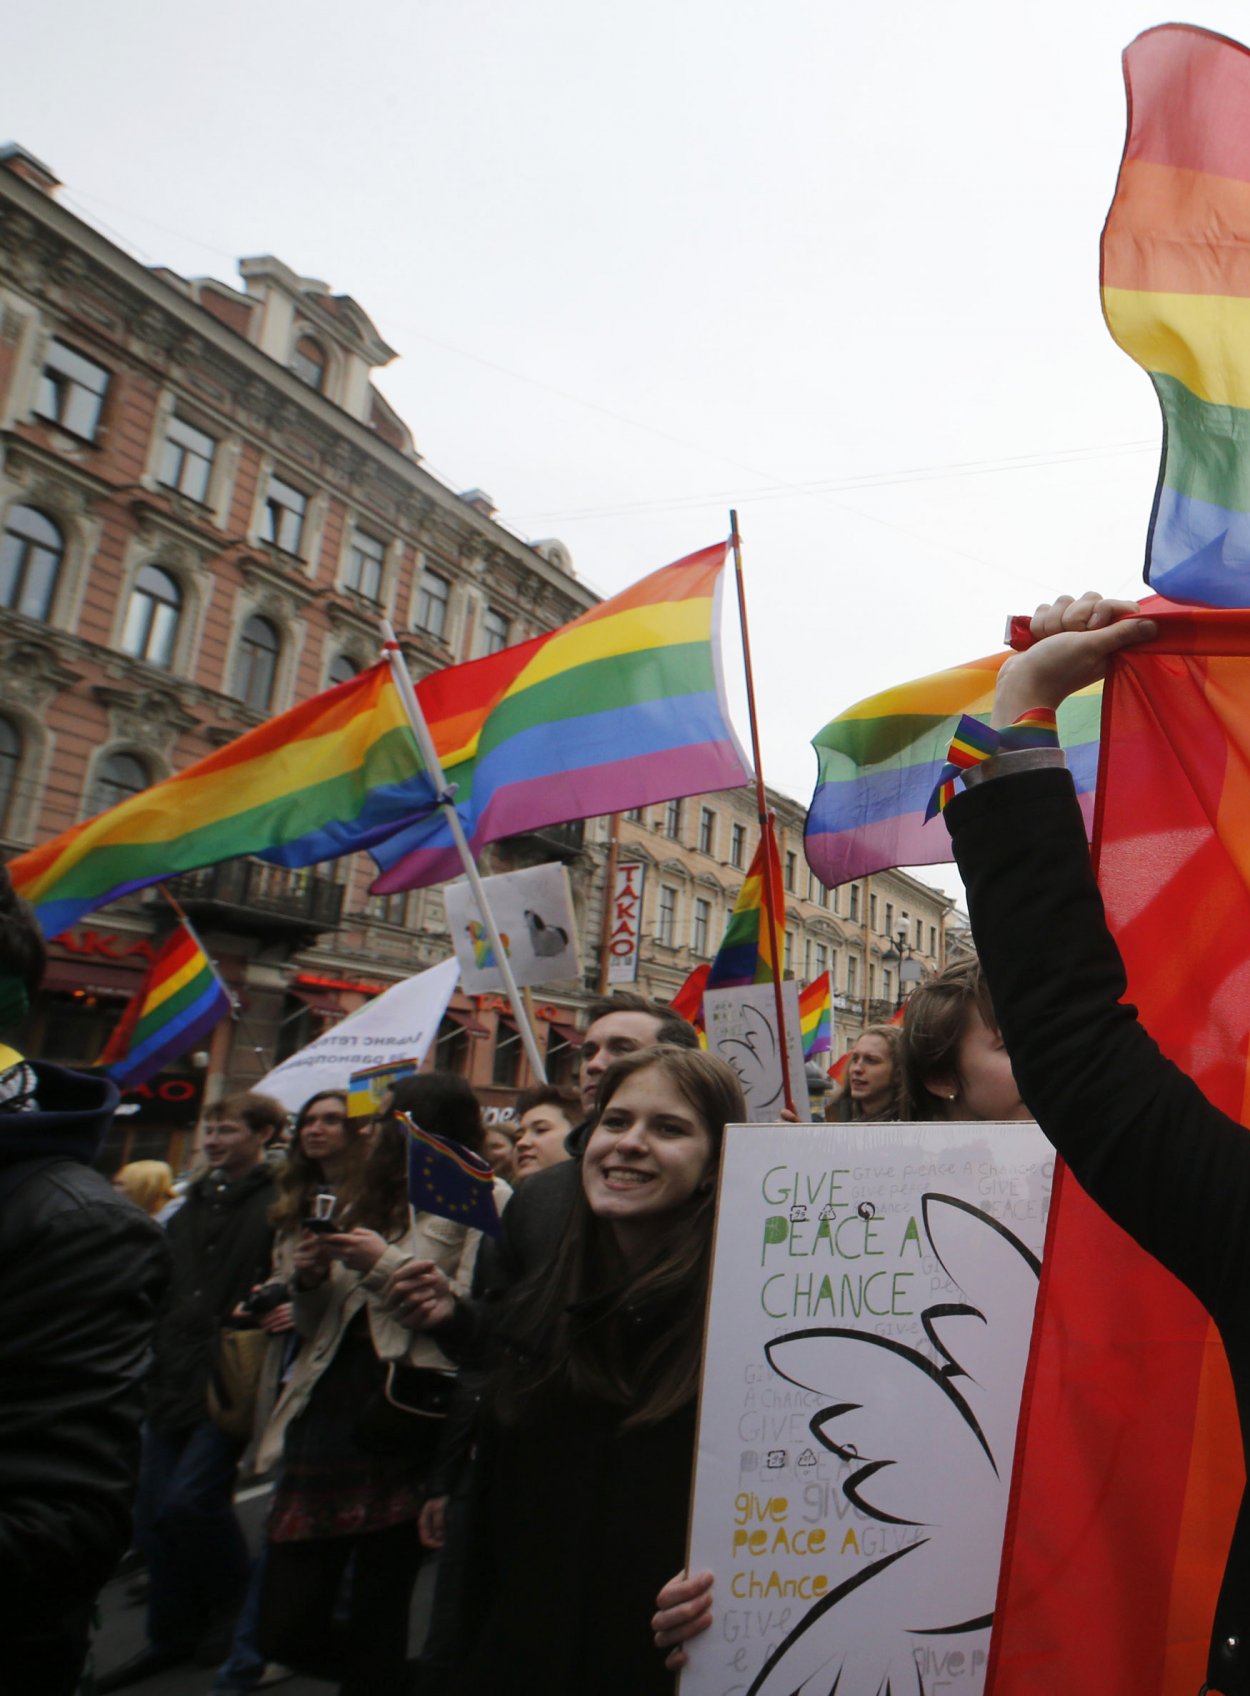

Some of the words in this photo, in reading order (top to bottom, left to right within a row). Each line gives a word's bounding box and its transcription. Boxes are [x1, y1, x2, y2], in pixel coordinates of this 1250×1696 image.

[761, 1164, 851, 1207] GIVE
[978, 1176, 1020, 1196] GIVE
[760, 1215, 886, 1267] PEACE
[899, 1216, 922, 1258] A
[761, 1271, 914, 1318] CHANCE
[743, 1388, 755, 1408] A
[737, 1410, 805, 1443] GIVE
[733, 1491, 789, 1526] give
[840, 1527, 861, 1556] A
